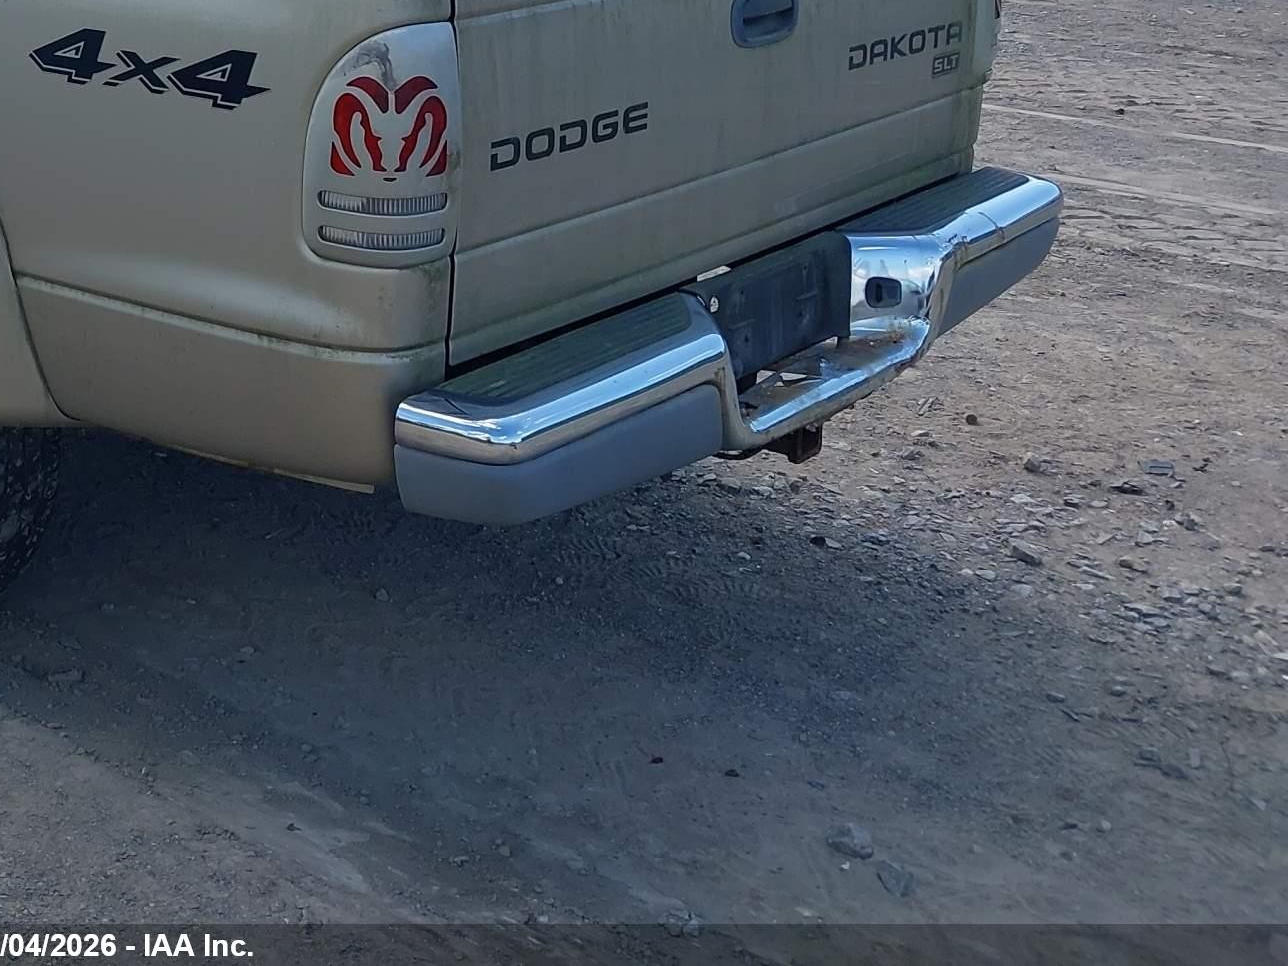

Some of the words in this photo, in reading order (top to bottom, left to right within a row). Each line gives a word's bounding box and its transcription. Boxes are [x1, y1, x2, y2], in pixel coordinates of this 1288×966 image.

[848, 21, 963, 71] DAKOTA
[933, 54, 960, 74] SLT
[489, 101, 649, 172] DODGE
